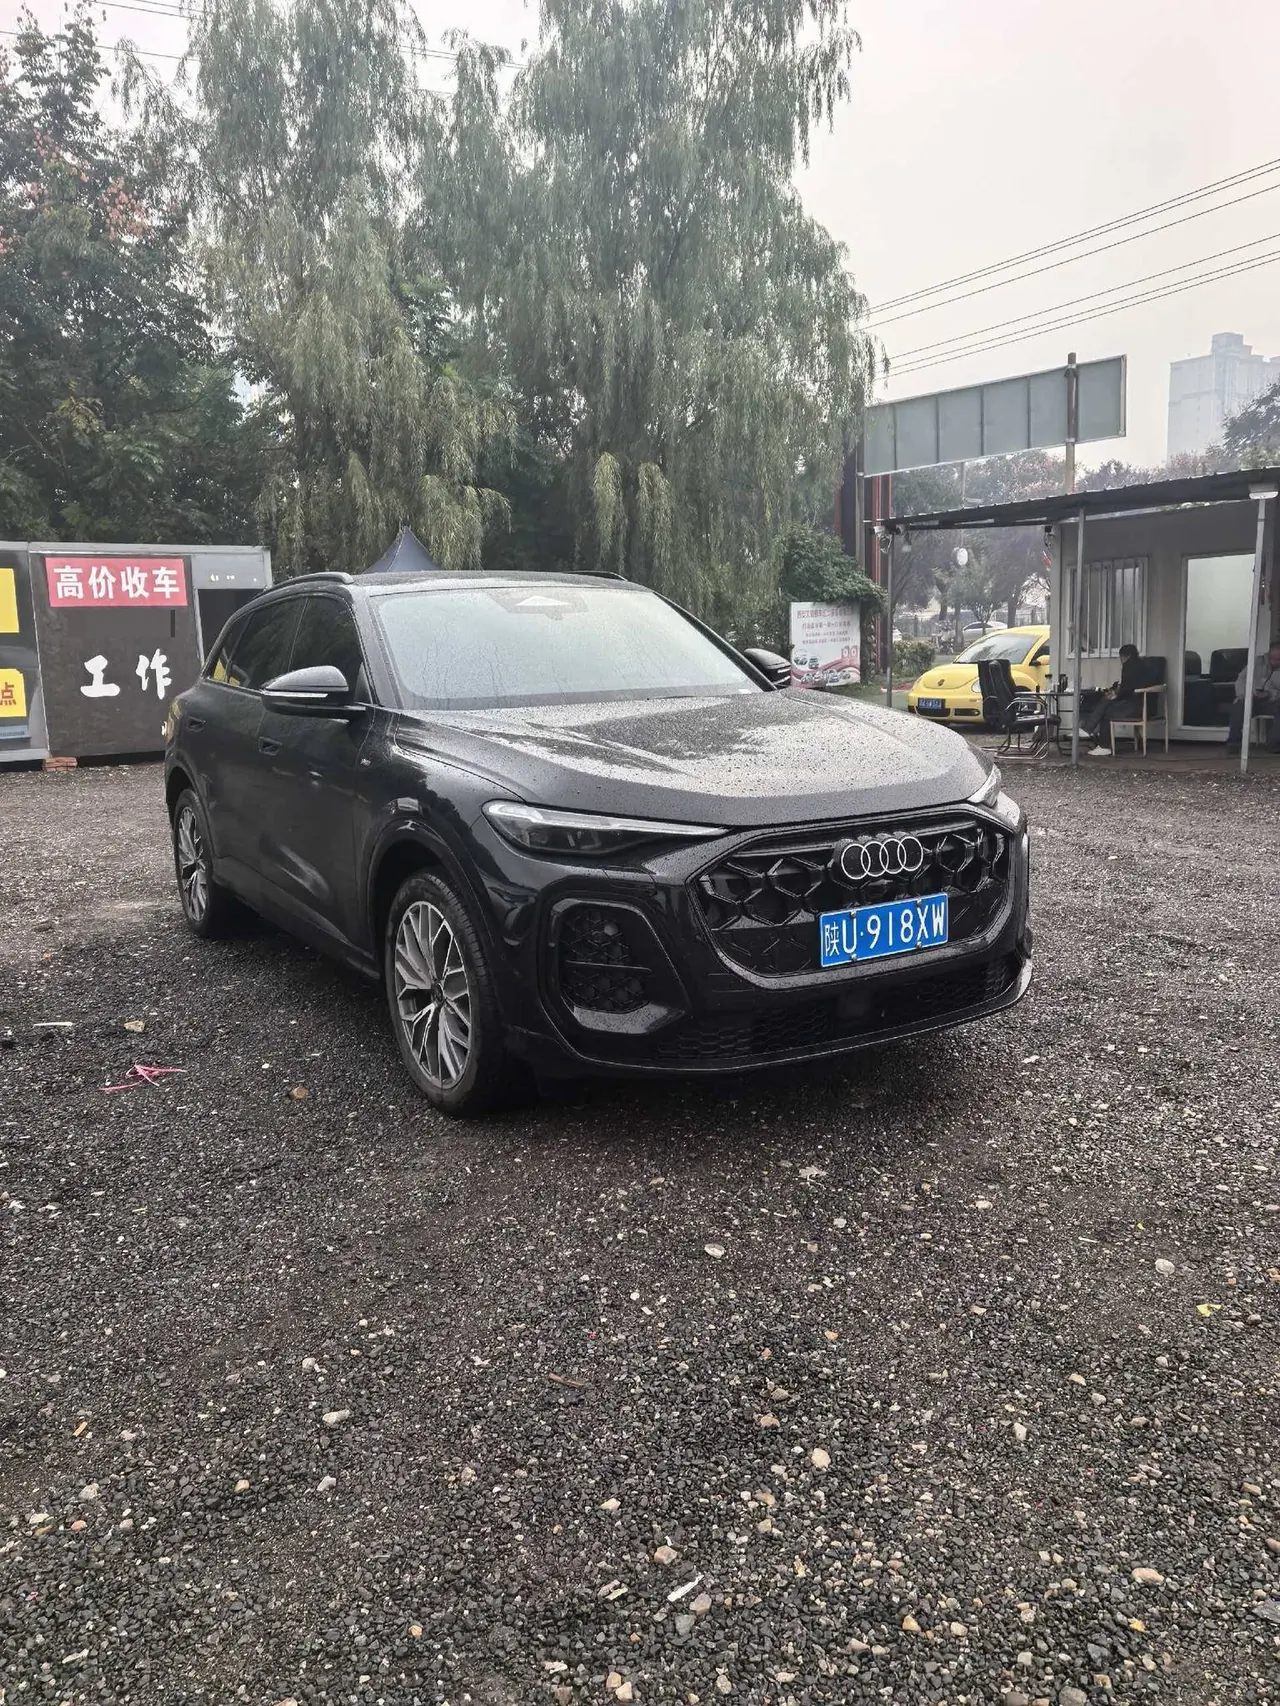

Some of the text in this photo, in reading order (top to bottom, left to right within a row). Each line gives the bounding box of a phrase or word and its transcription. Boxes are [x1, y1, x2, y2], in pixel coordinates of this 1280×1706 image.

[54, 565, 180, 599] 高价收车
[0, 682, 17, 705] 点
